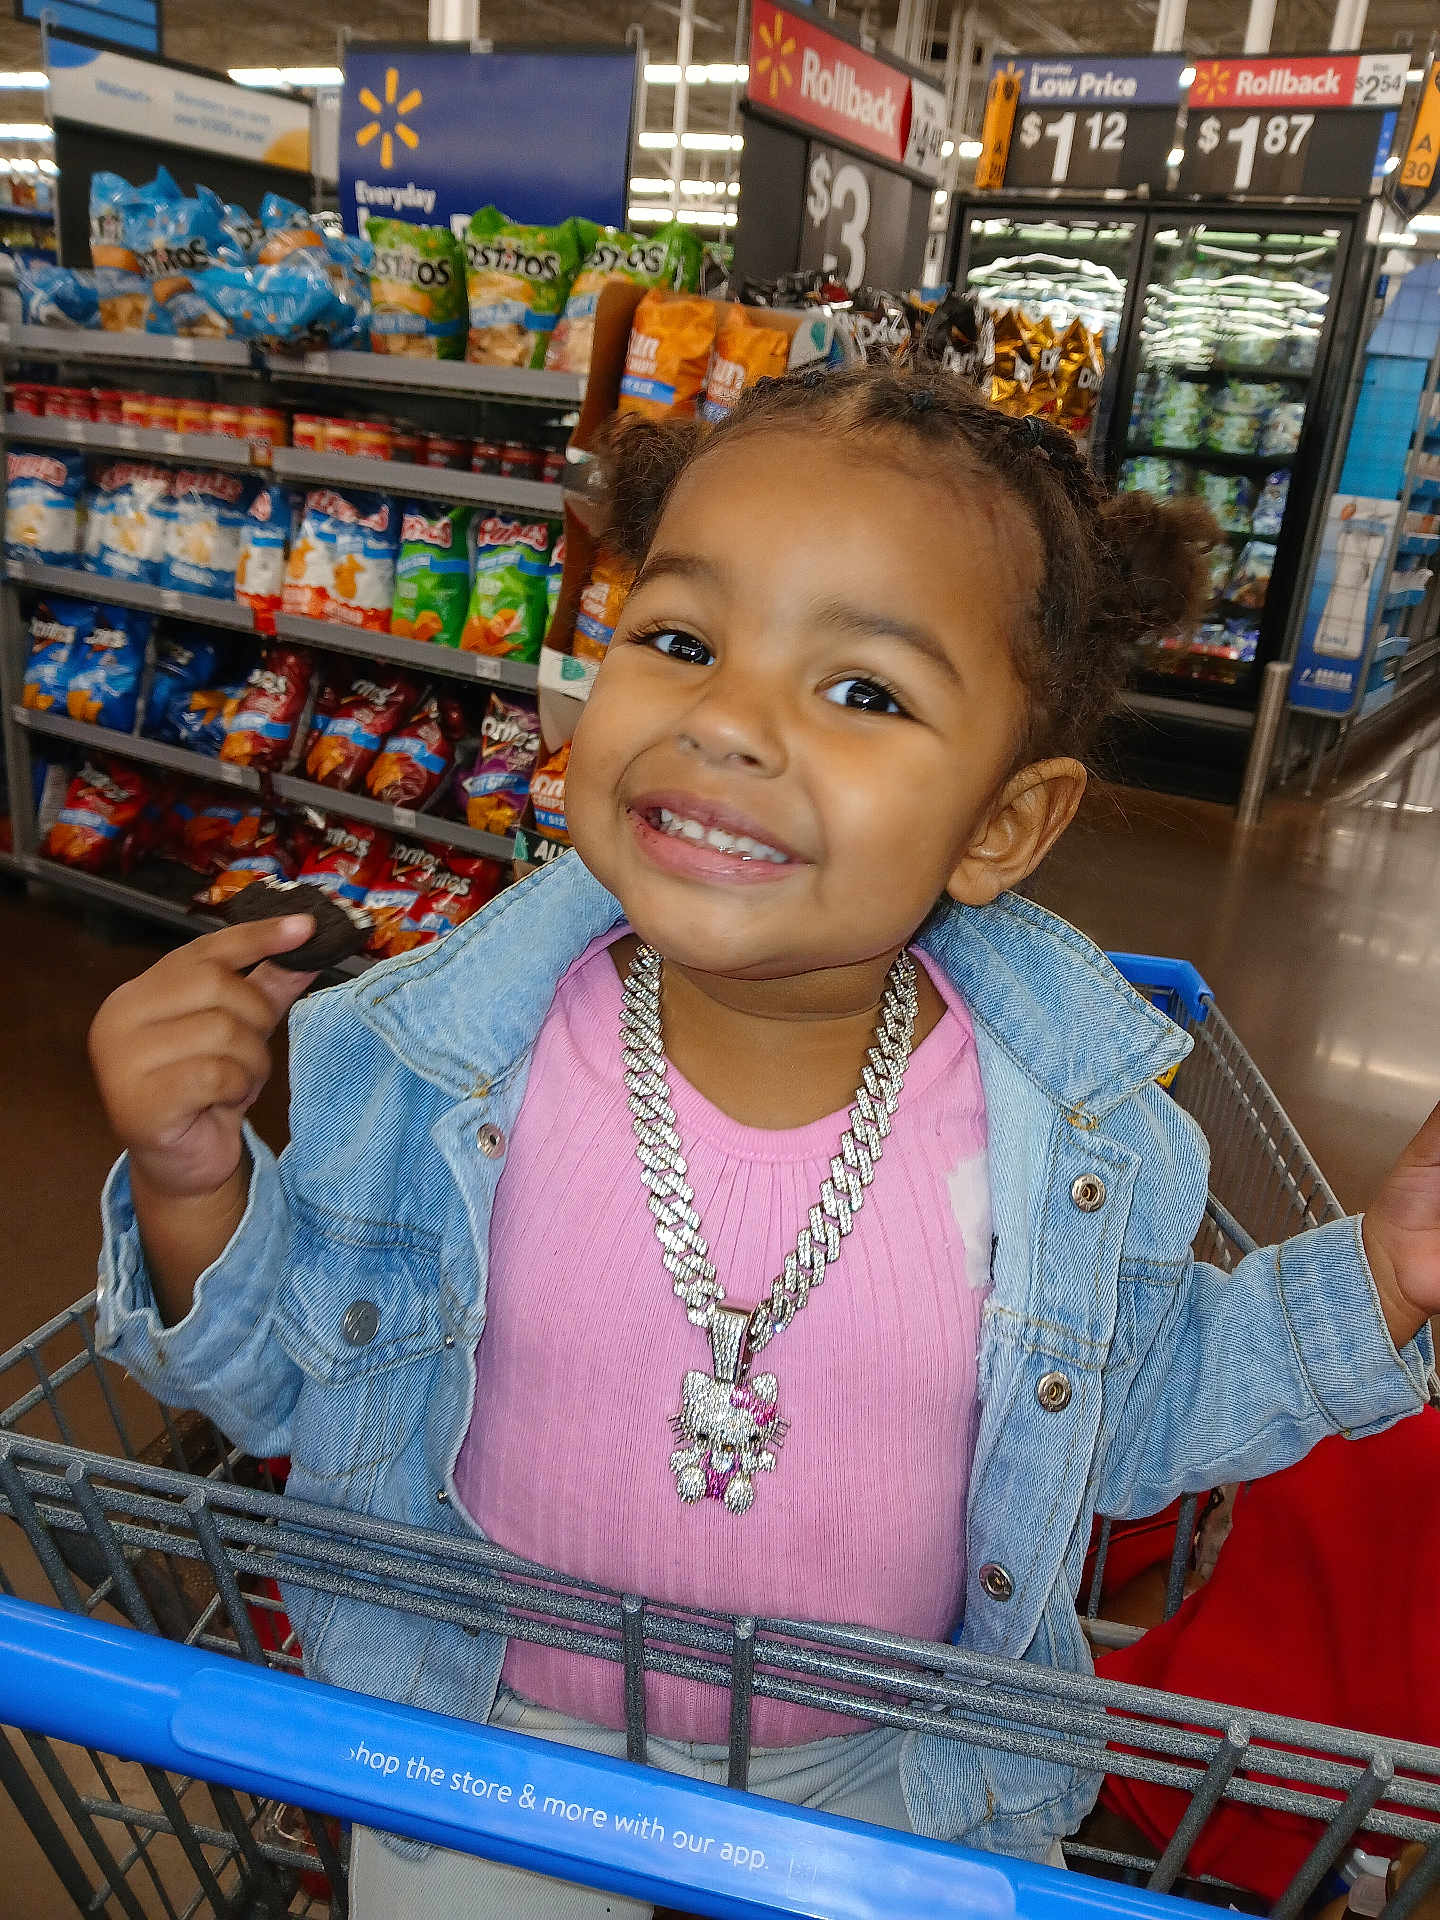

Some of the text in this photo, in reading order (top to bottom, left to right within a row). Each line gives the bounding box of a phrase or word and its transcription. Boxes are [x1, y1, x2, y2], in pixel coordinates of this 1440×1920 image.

[801, 47, 897, 137] Rollback
[1029, 70, 1138, 98] Low Price
[1235, 67, 1343, 96] Rollback
[1416, 133, 1432, 153] A
[1404, 161, 1431, 182] 30
[355, 180, 437, 215] Everyday
[341, 1740, 769, 1871] hop the store & more with our app.
